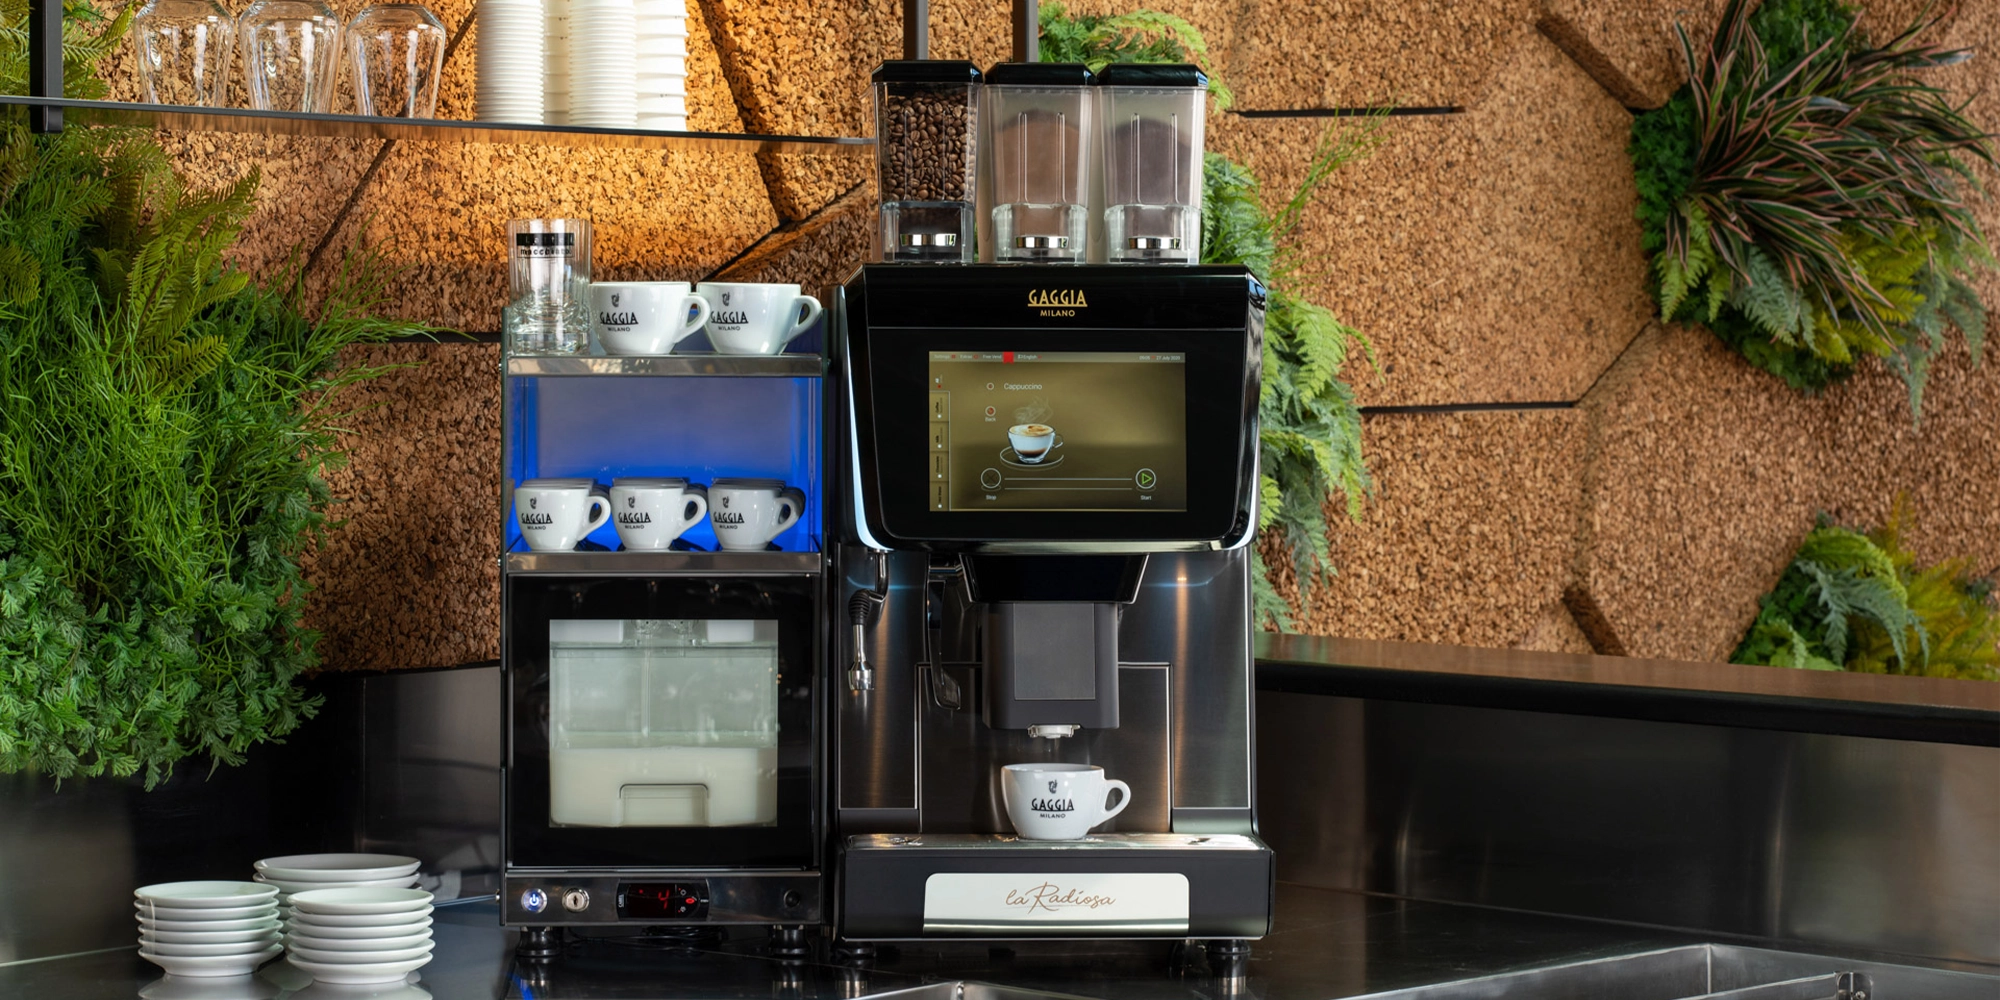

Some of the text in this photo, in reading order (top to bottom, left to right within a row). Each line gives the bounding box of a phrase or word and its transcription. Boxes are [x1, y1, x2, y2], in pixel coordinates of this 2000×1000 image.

[1027, 289, 1088, 307] GAGGIA
[599, 311, 638, 325] GAGGIA
[710, 311, 749, 324] GAGGIA
[1040, 309, 1076, 317] MILANO
[1003, 382, 1043, 391] Cappuccino
[521, 512, 553, 524] GAGGIA
[618, 512, 651, 524] GAGGIA
[713, 512, 745, 524] GAGGIA
[1031, 798, 1075, 811] GAGGIA
[657, 889, 670, 909] 4
[1005, 881, 1116, 914] la Radiosa
